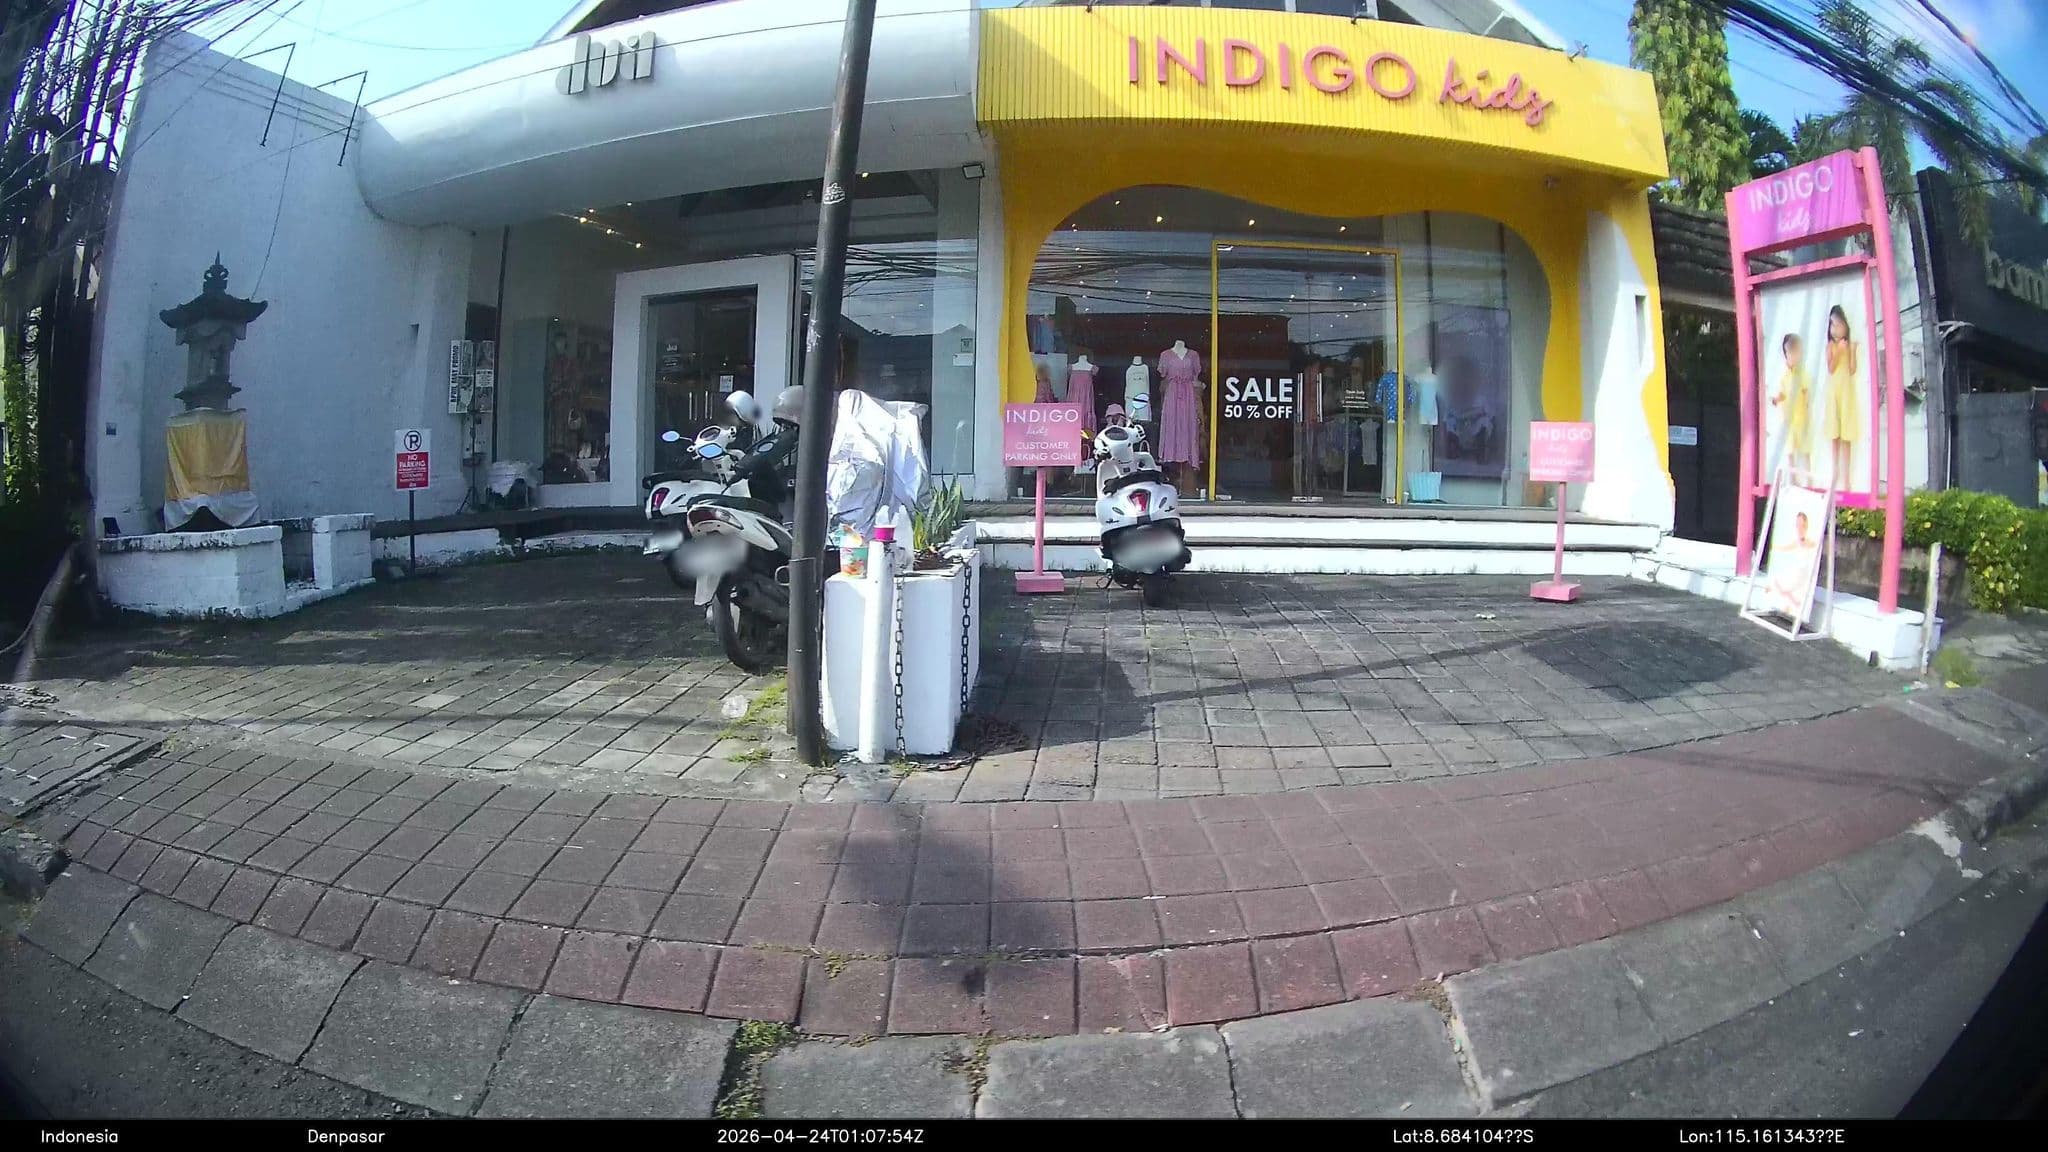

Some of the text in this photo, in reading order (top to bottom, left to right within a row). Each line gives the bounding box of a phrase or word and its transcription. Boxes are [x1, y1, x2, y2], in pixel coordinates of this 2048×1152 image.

[1127, 36, 1554, 127] INDIGO kids
[1749, 165, 1833, 213] INDIGO
[1777, 207, 1811, 233] kids
[1225, 376, 1293, 402] SALE
[1006, 409, 1079, 423] INDIGO
[1224, 405, 1293, 419] 50 % OFF
[1530, 428, 1593, 441] INDIGO
[1015, 441, 1070, 450] CUSTOMER
[1005, 452, 1078, 461] PARKING ONLY
